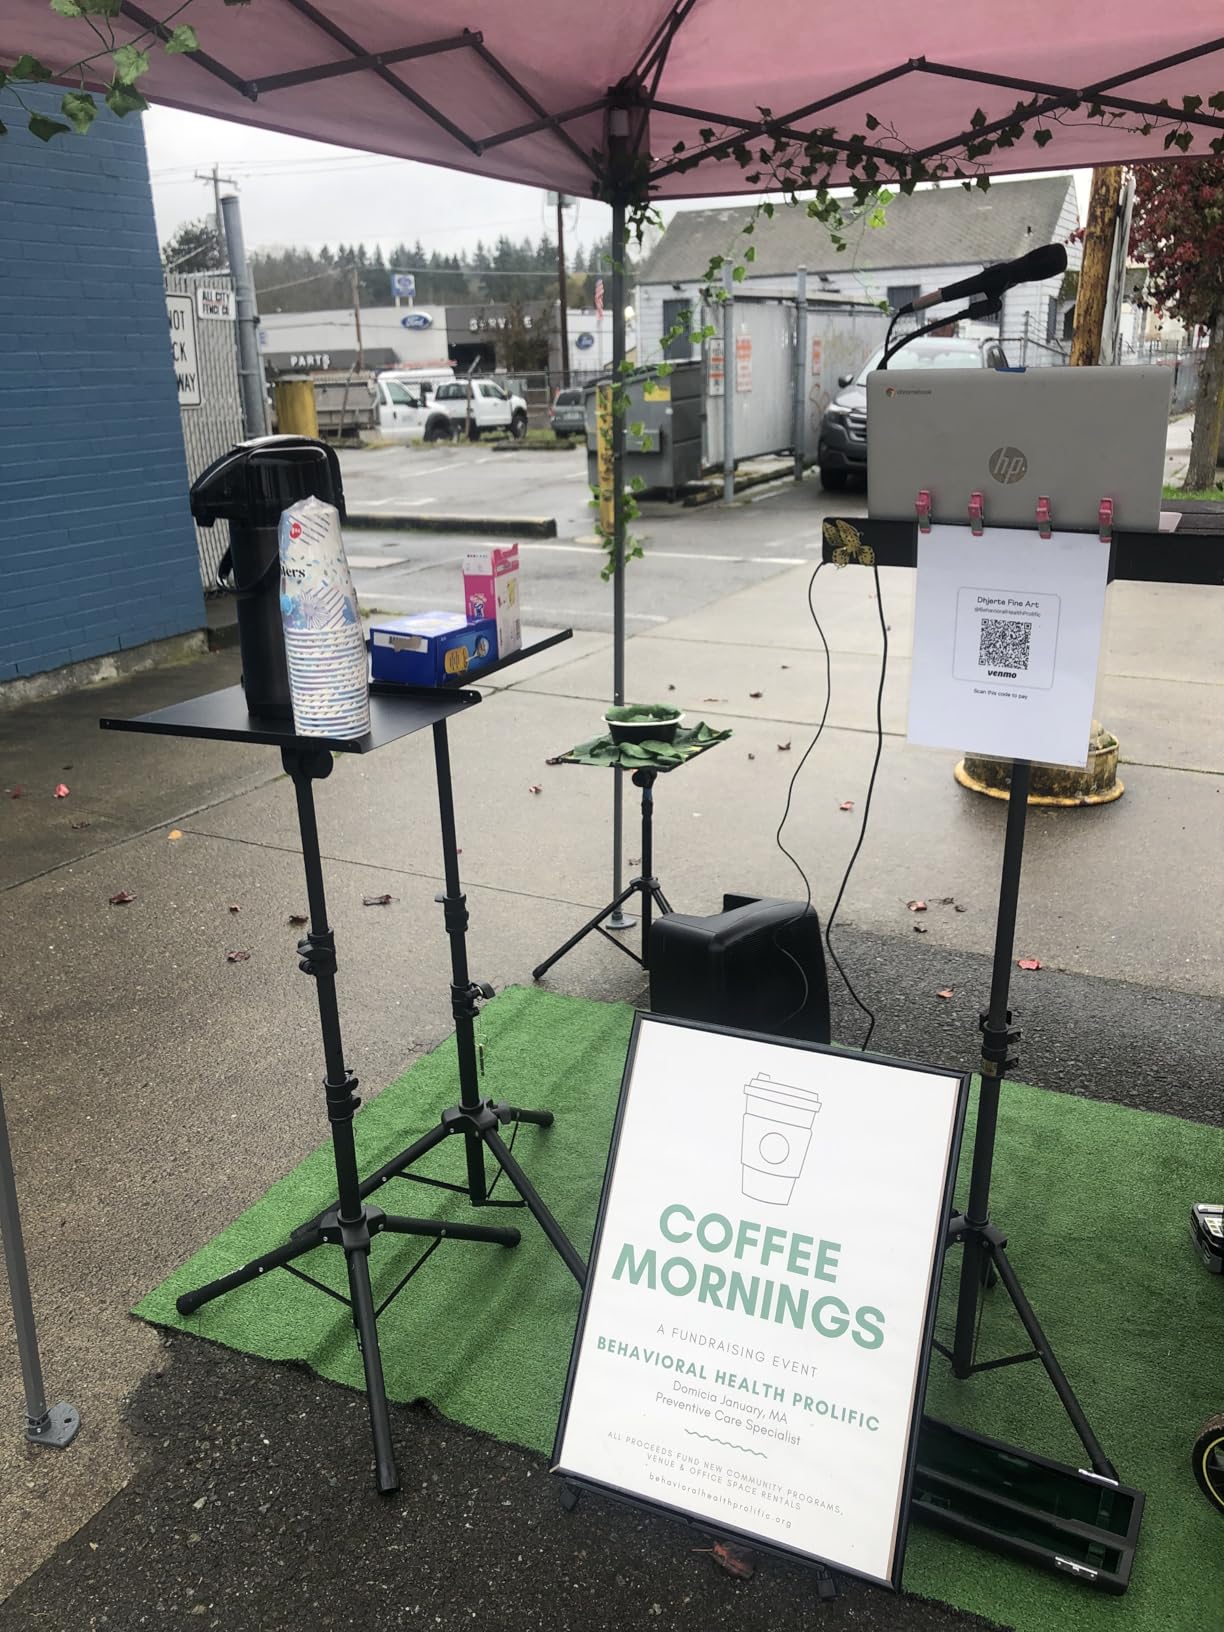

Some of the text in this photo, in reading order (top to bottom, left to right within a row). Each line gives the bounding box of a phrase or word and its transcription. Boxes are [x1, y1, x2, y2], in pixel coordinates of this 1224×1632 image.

[290, 353, 330, 368] PARTS
[991, 447, 1025, 484] hp
[977, 596, 1040, 608] Dhjerte Fine Art
[987, 669, 1017, 679] venmo
[659, 1203, 842, 1284] COFFEE
[611, 1242, 886, 1350] MORNINGS
[656, 1323, 818, 1378] A FUNDRAISING EVENT
[597, 1335, 880, 1432] BEHAVIORAL HEALTH PROLIFIC
[673, 1380, 788, 1425] Domicia January, MA
[655, 1391, 800, 1446] Preventive Care Specialist
[607, 1431, 844, 1516] ALL PROCEEDS FUND NEW COMMUNITY PROGRAMS,
[647, 1452, 801, 1511] VENUE & OFFICE SPACE RENTALS
[649, 1472, 792, 1529] behavioralhealthprolific.org
